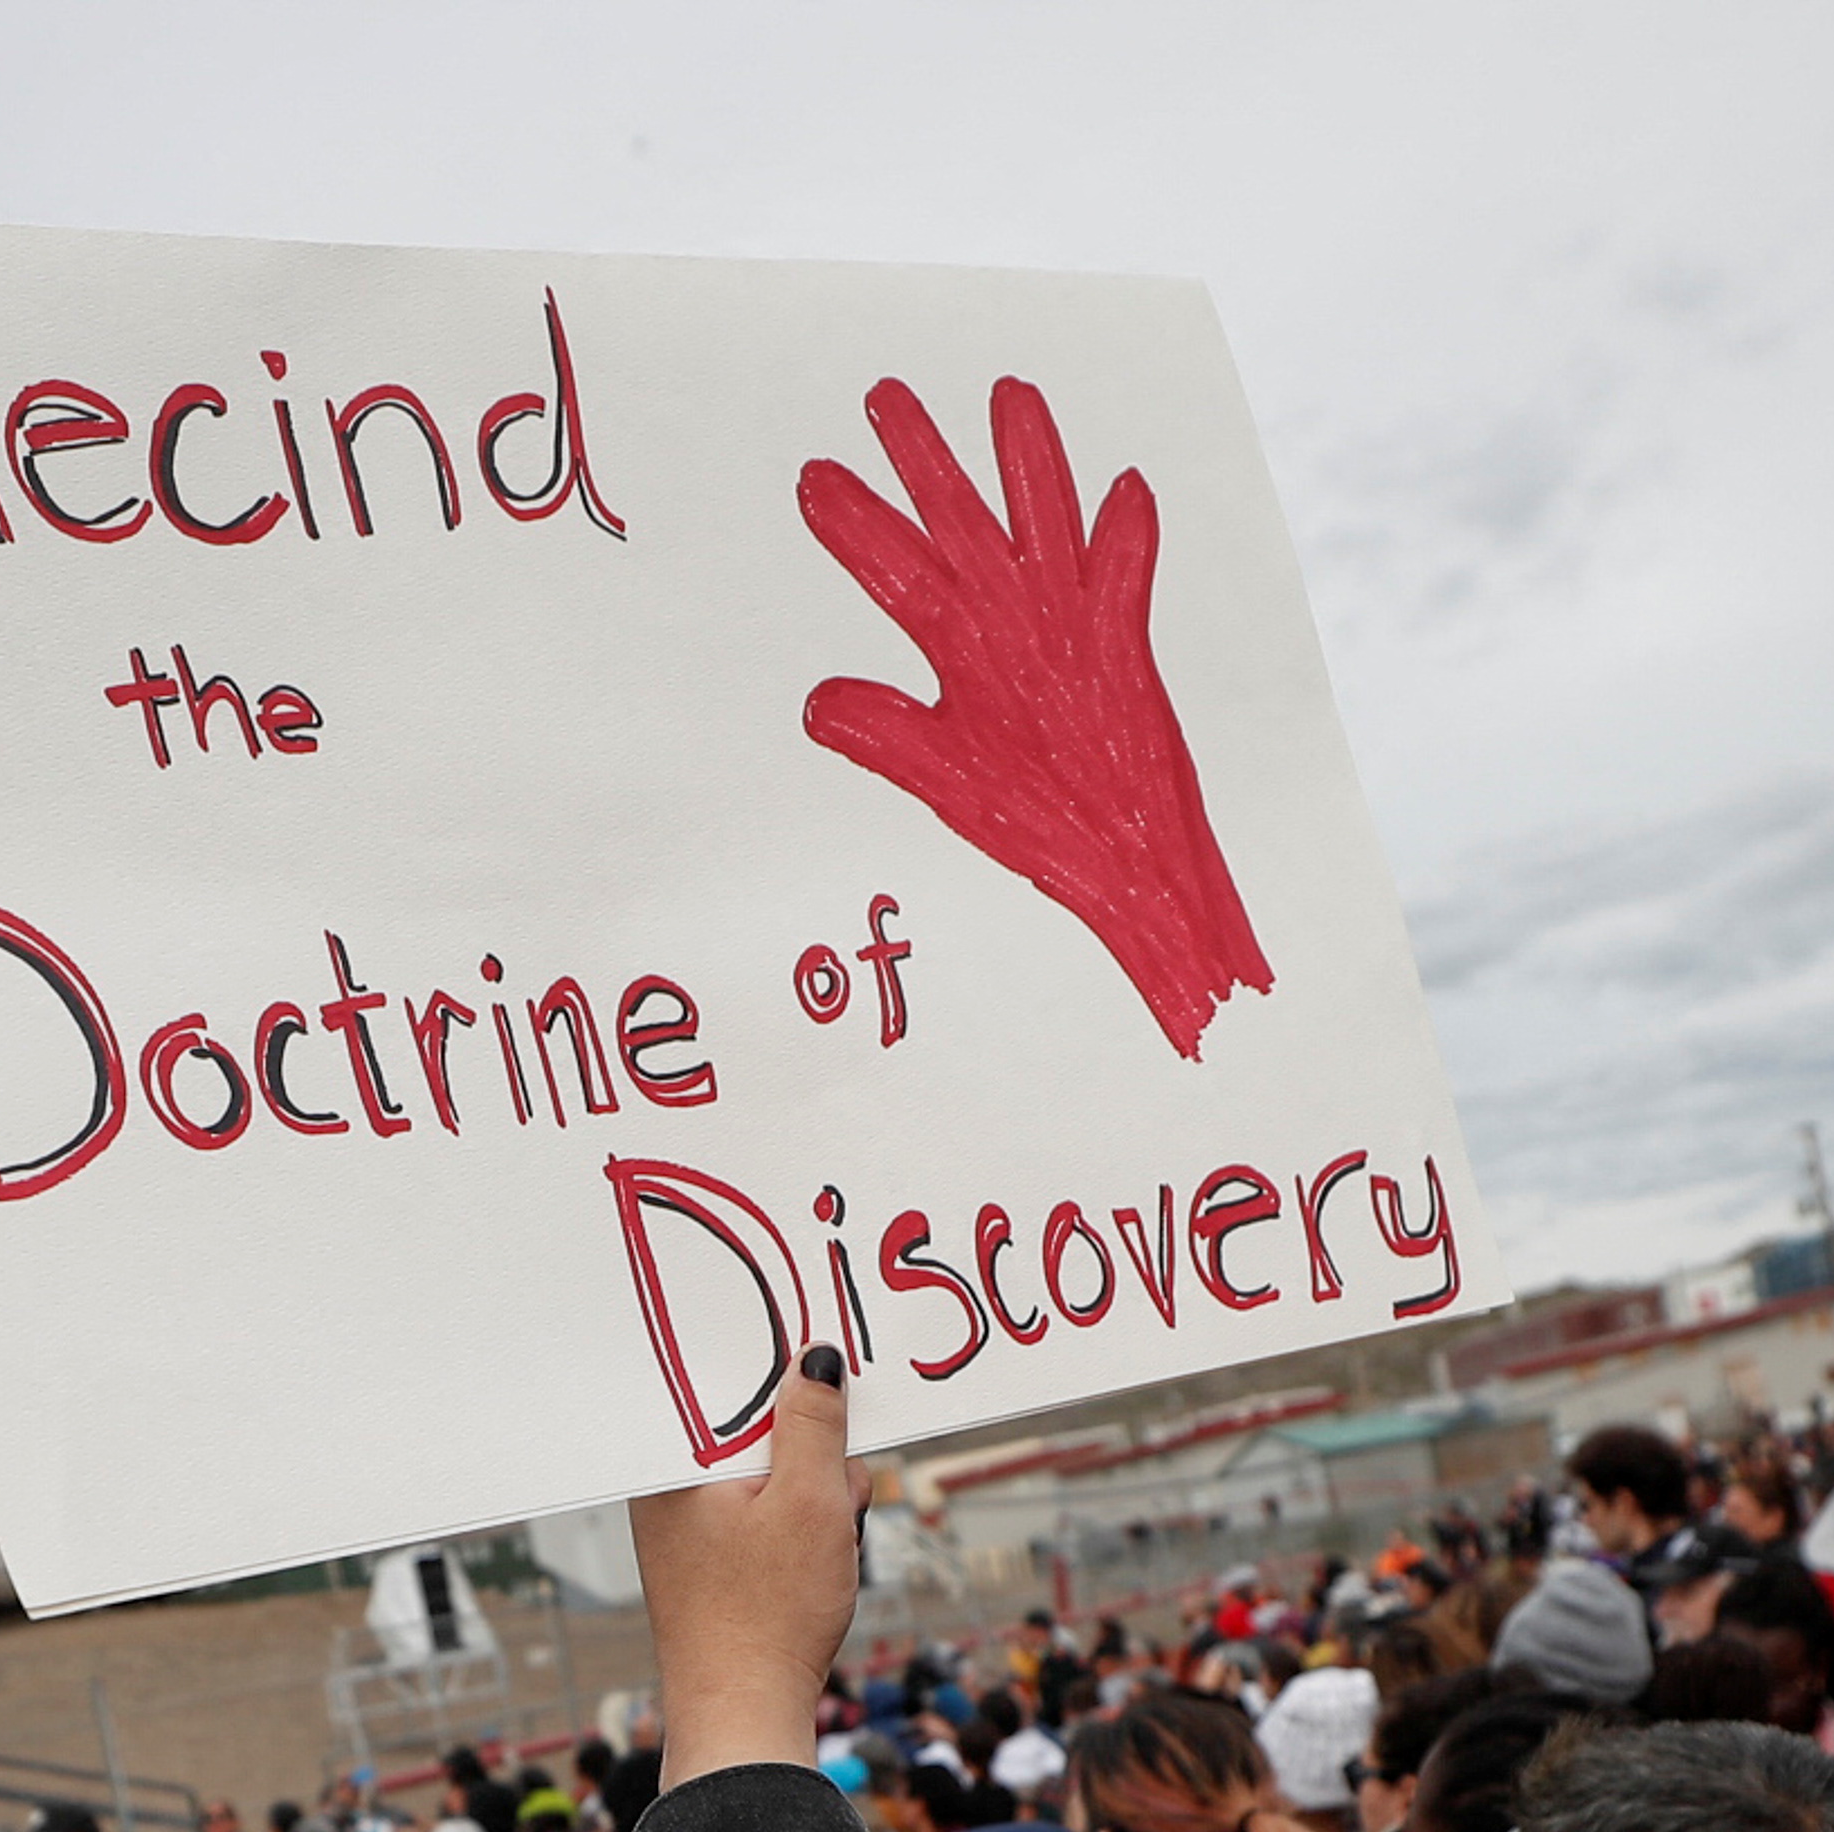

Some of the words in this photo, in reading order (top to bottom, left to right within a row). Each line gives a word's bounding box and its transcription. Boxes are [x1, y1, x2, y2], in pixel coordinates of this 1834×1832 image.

[106, 645, 323, 768] the
[794, 894, 911, 1047] of
[604, 1151, 1460, 1468] Discovery
